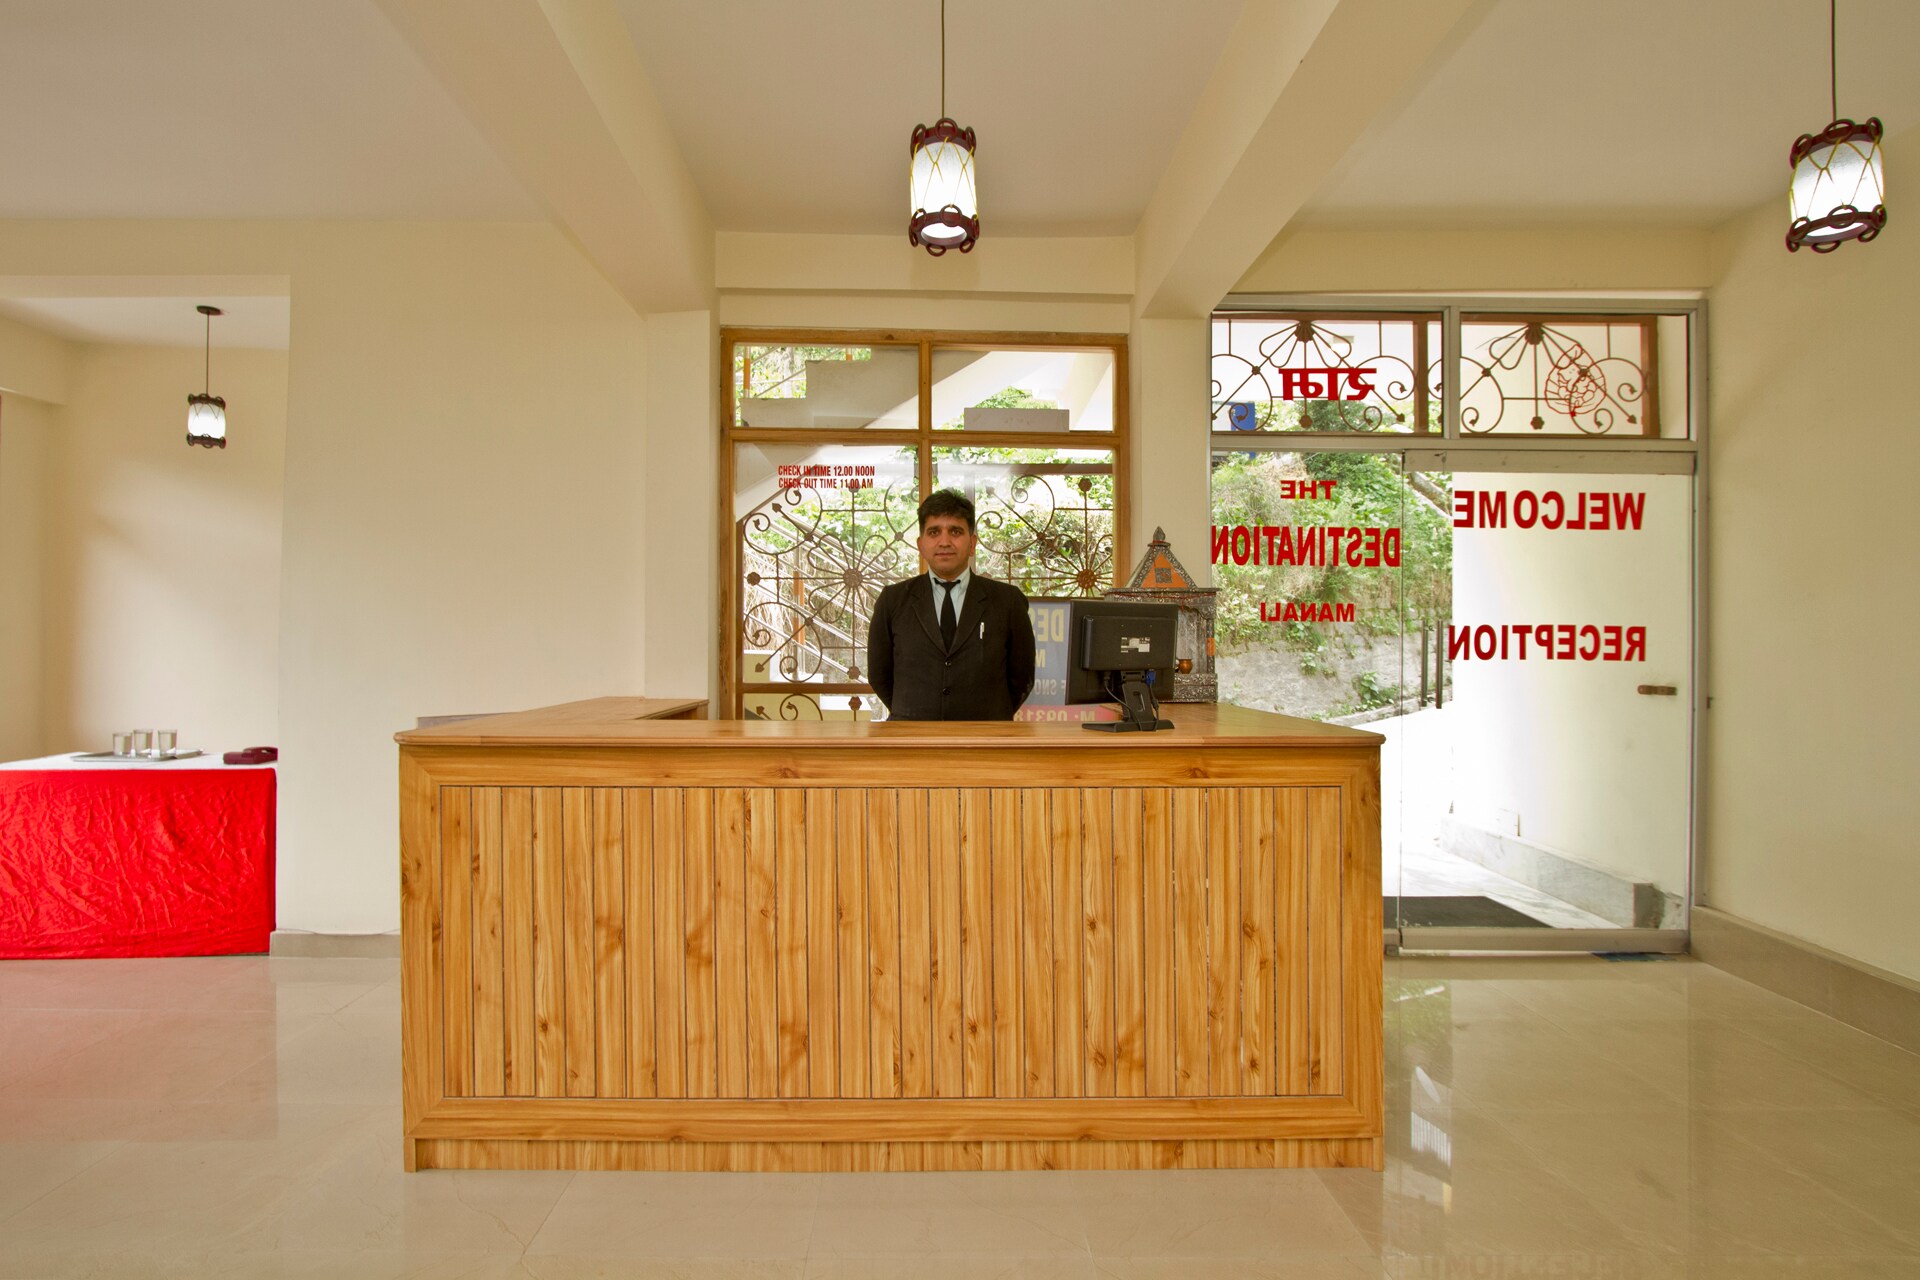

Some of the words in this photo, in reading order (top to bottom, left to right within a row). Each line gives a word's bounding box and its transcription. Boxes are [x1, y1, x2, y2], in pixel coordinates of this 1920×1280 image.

[778, 465, 801, 476] CHECK
[803, 466, 811, 476] IN
[813, 466, 831, 476] TIME
[834, 466, 853, 476] 12.00
[855, 466, 875, 476] NOON
[778, 478, 802, 489] CHECK
[804, 478, 818, 489] OUT
[820, 478, 837, 489] TIME
[840, 478, 860, 489] 11.00
[861, 478, 874, 489] AM
